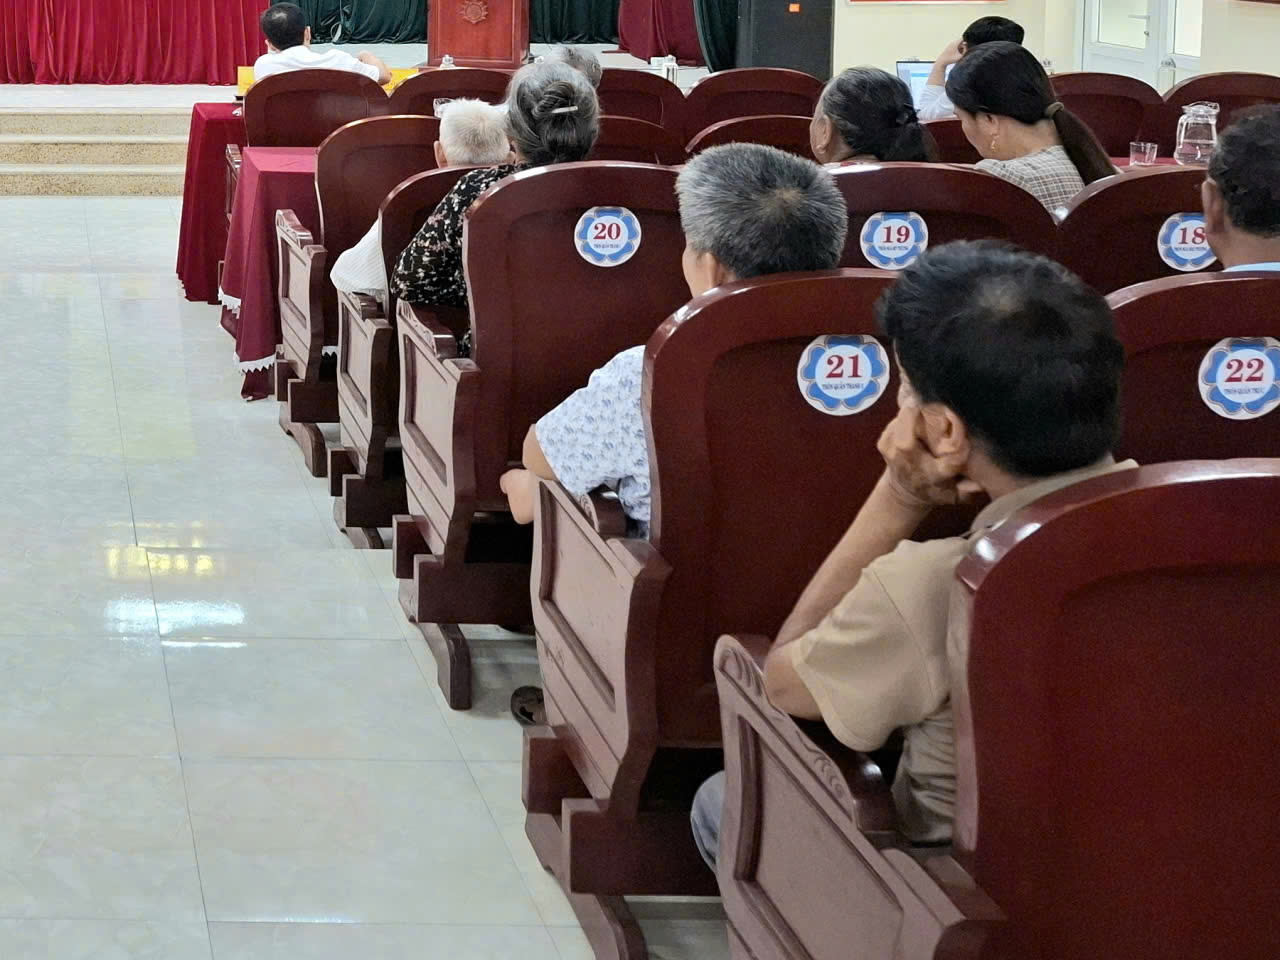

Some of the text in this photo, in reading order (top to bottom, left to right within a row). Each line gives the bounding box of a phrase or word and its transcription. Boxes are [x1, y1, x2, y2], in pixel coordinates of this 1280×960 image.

[593, 223, 621, 240] 20
[882, 225, 910, 243] 19
[1178, 227, 1206, 245] 18
[825, 353, 862, 378] 21
[1224, 358, 1264, 382] 22
